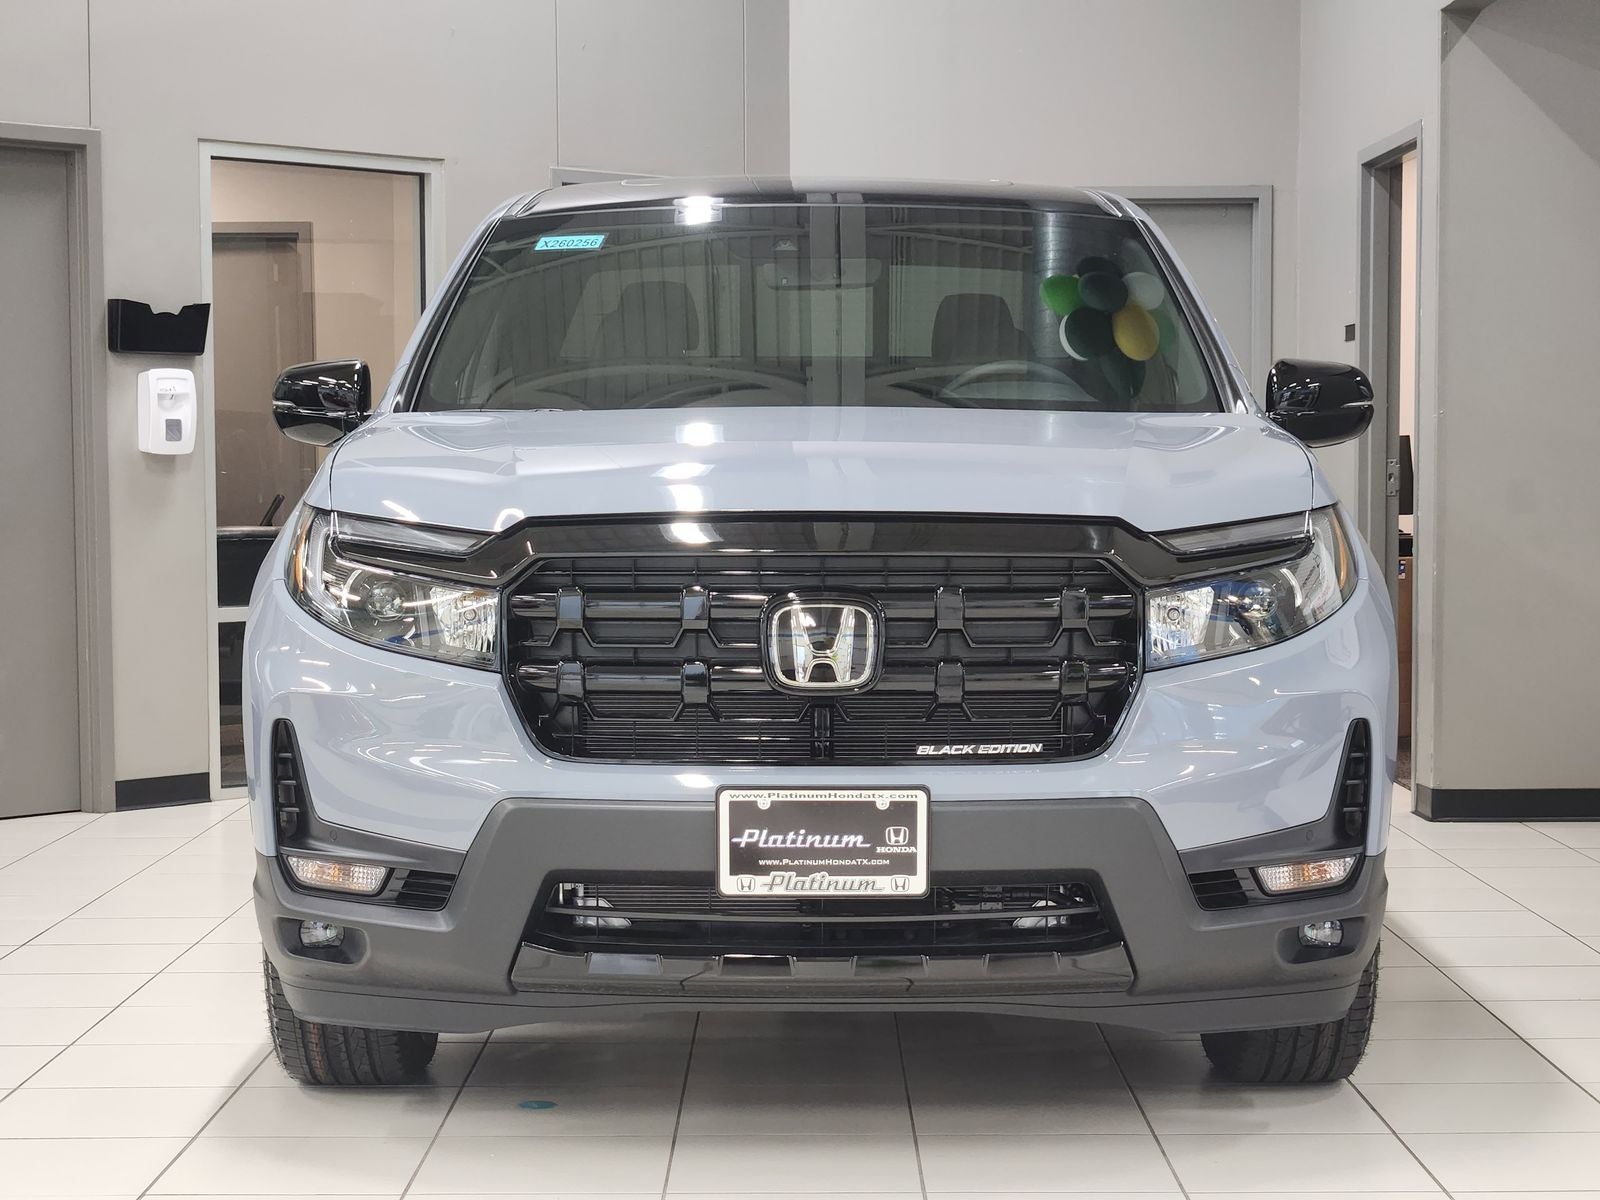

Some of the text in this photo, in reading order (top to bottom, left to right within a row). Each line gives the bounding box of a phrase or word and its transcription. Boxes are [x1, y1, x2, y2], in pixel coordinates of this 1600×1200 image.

[540, 239, 599, 248] X260256
[916, 743, 1042, 755] BLACK EDITION
[731, 829, 871, 849] Platinum
[760, 872, 886, 893] Platinum
